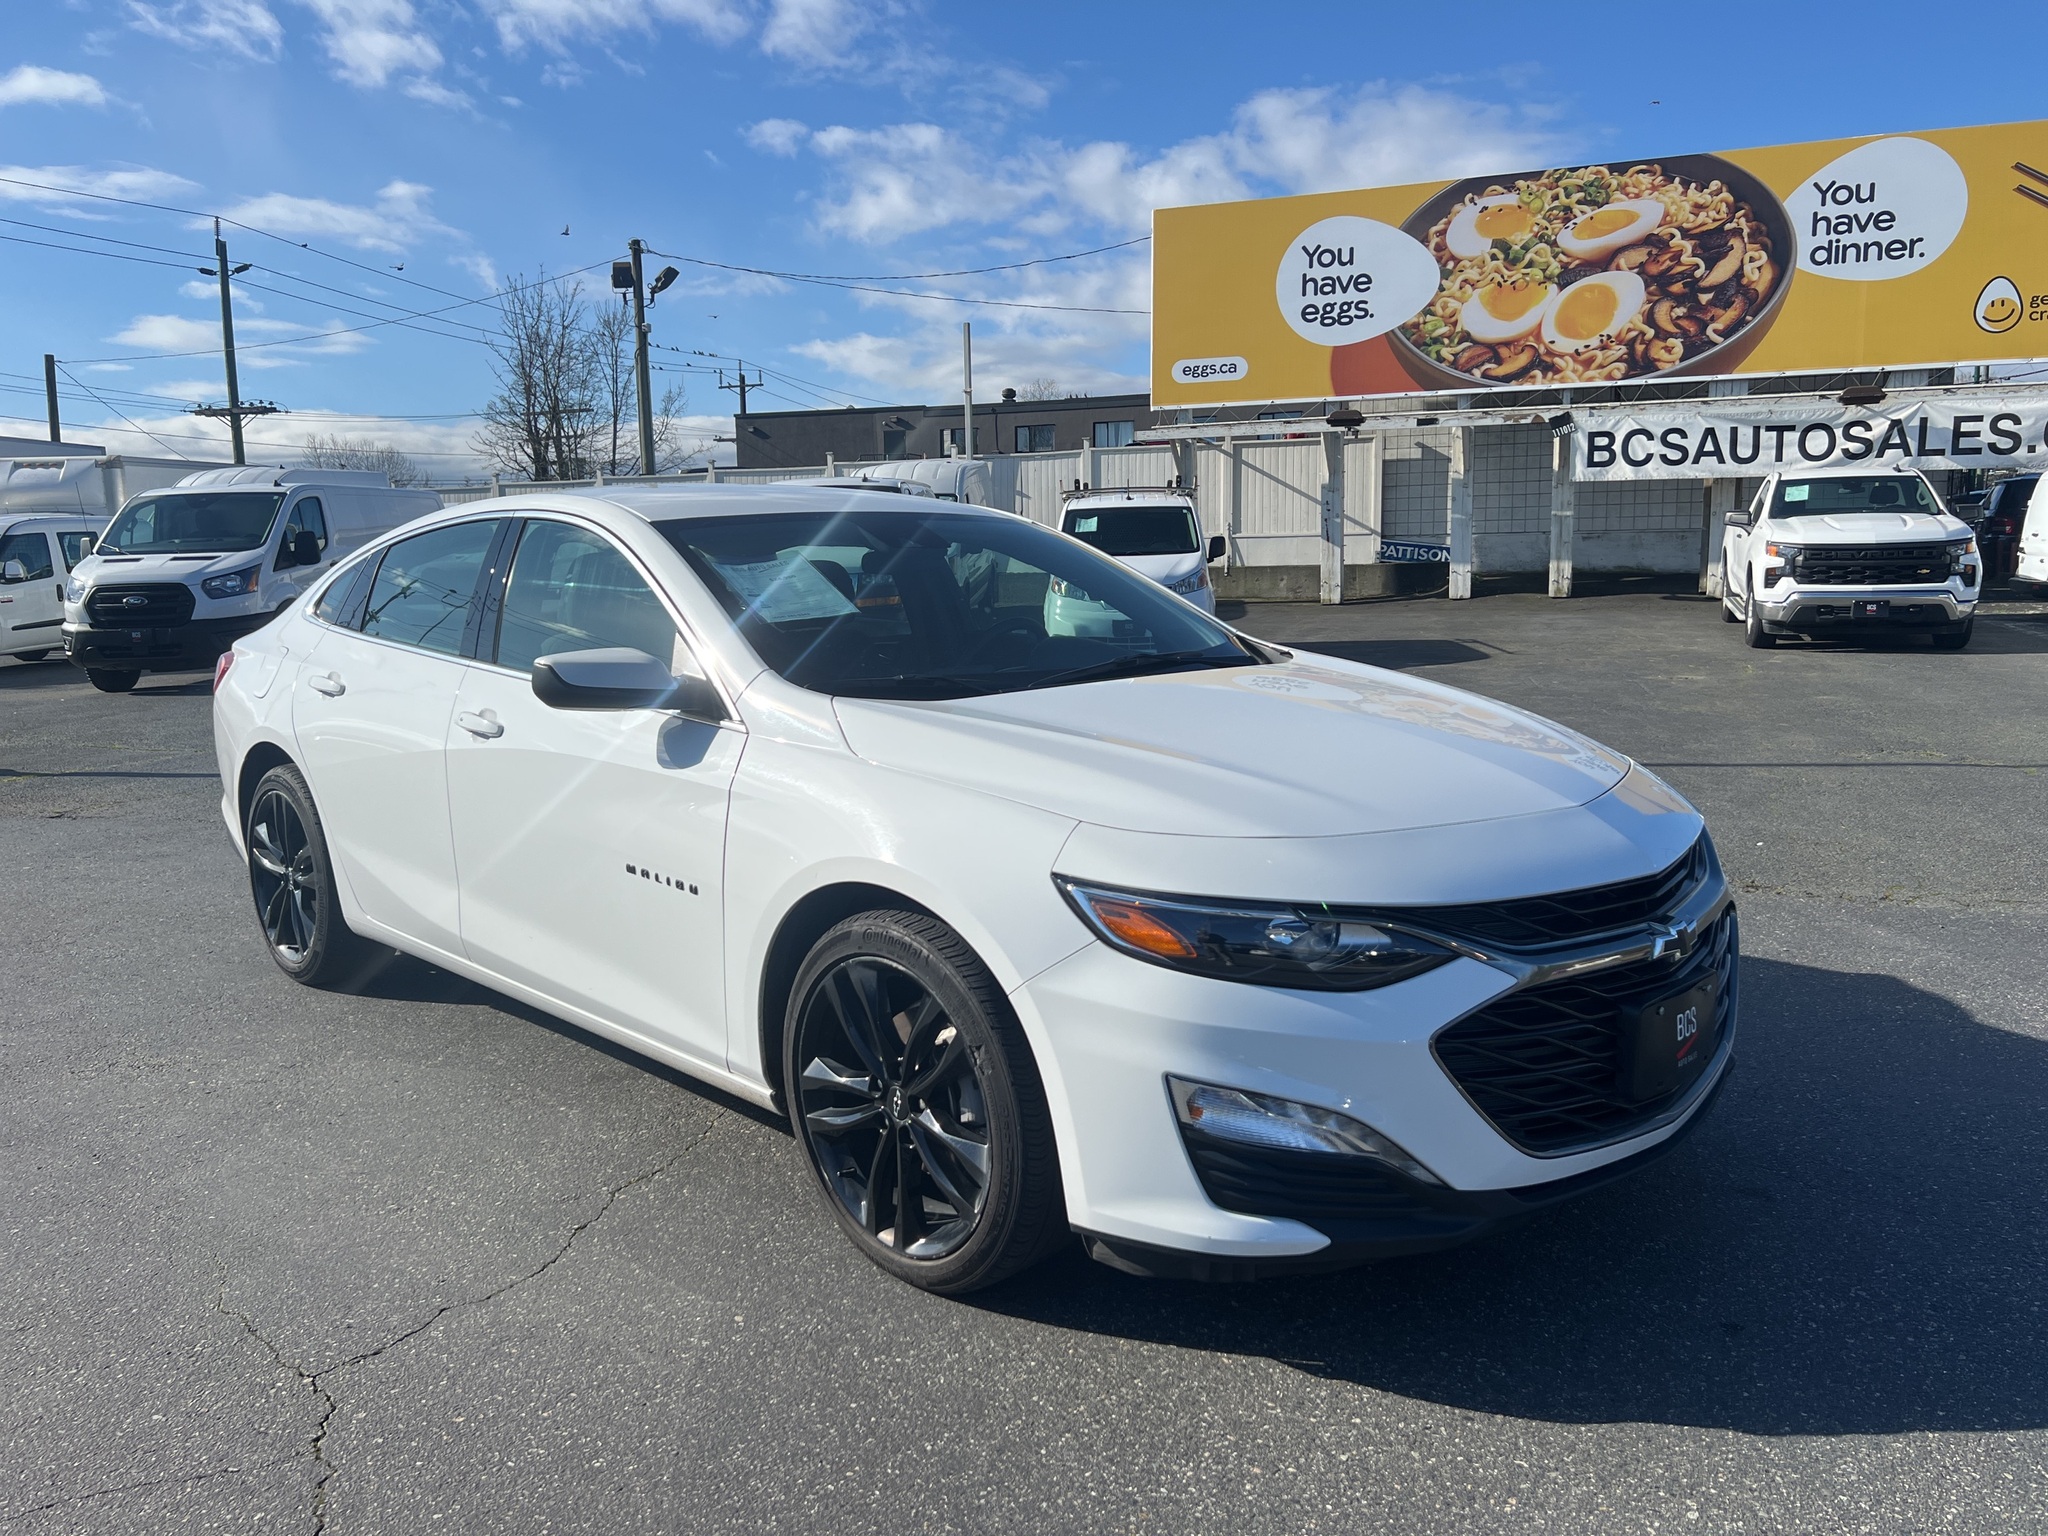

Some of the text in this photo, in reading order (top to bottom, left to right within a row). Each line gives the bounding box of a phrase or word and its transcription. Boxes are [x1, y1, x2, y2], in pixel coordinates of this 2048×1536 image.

[1813, 180, 1876, 207] You
[1811, 210, 1896, 237] have
[1301, 244, 1354, 269] You
[1809, 236, 1926, 266] dinner.
[1302, 273, 1373, 297] have
[1301, 300, 1374, 327] eggs.
[1182, 363, 1237, 378] eggs.ca
[1586, 412, 2048, 468] BCSAUTOSALES.
[862, 927, 923, 960] Continental
[1676, 1006, 1697, 1041] BCS
